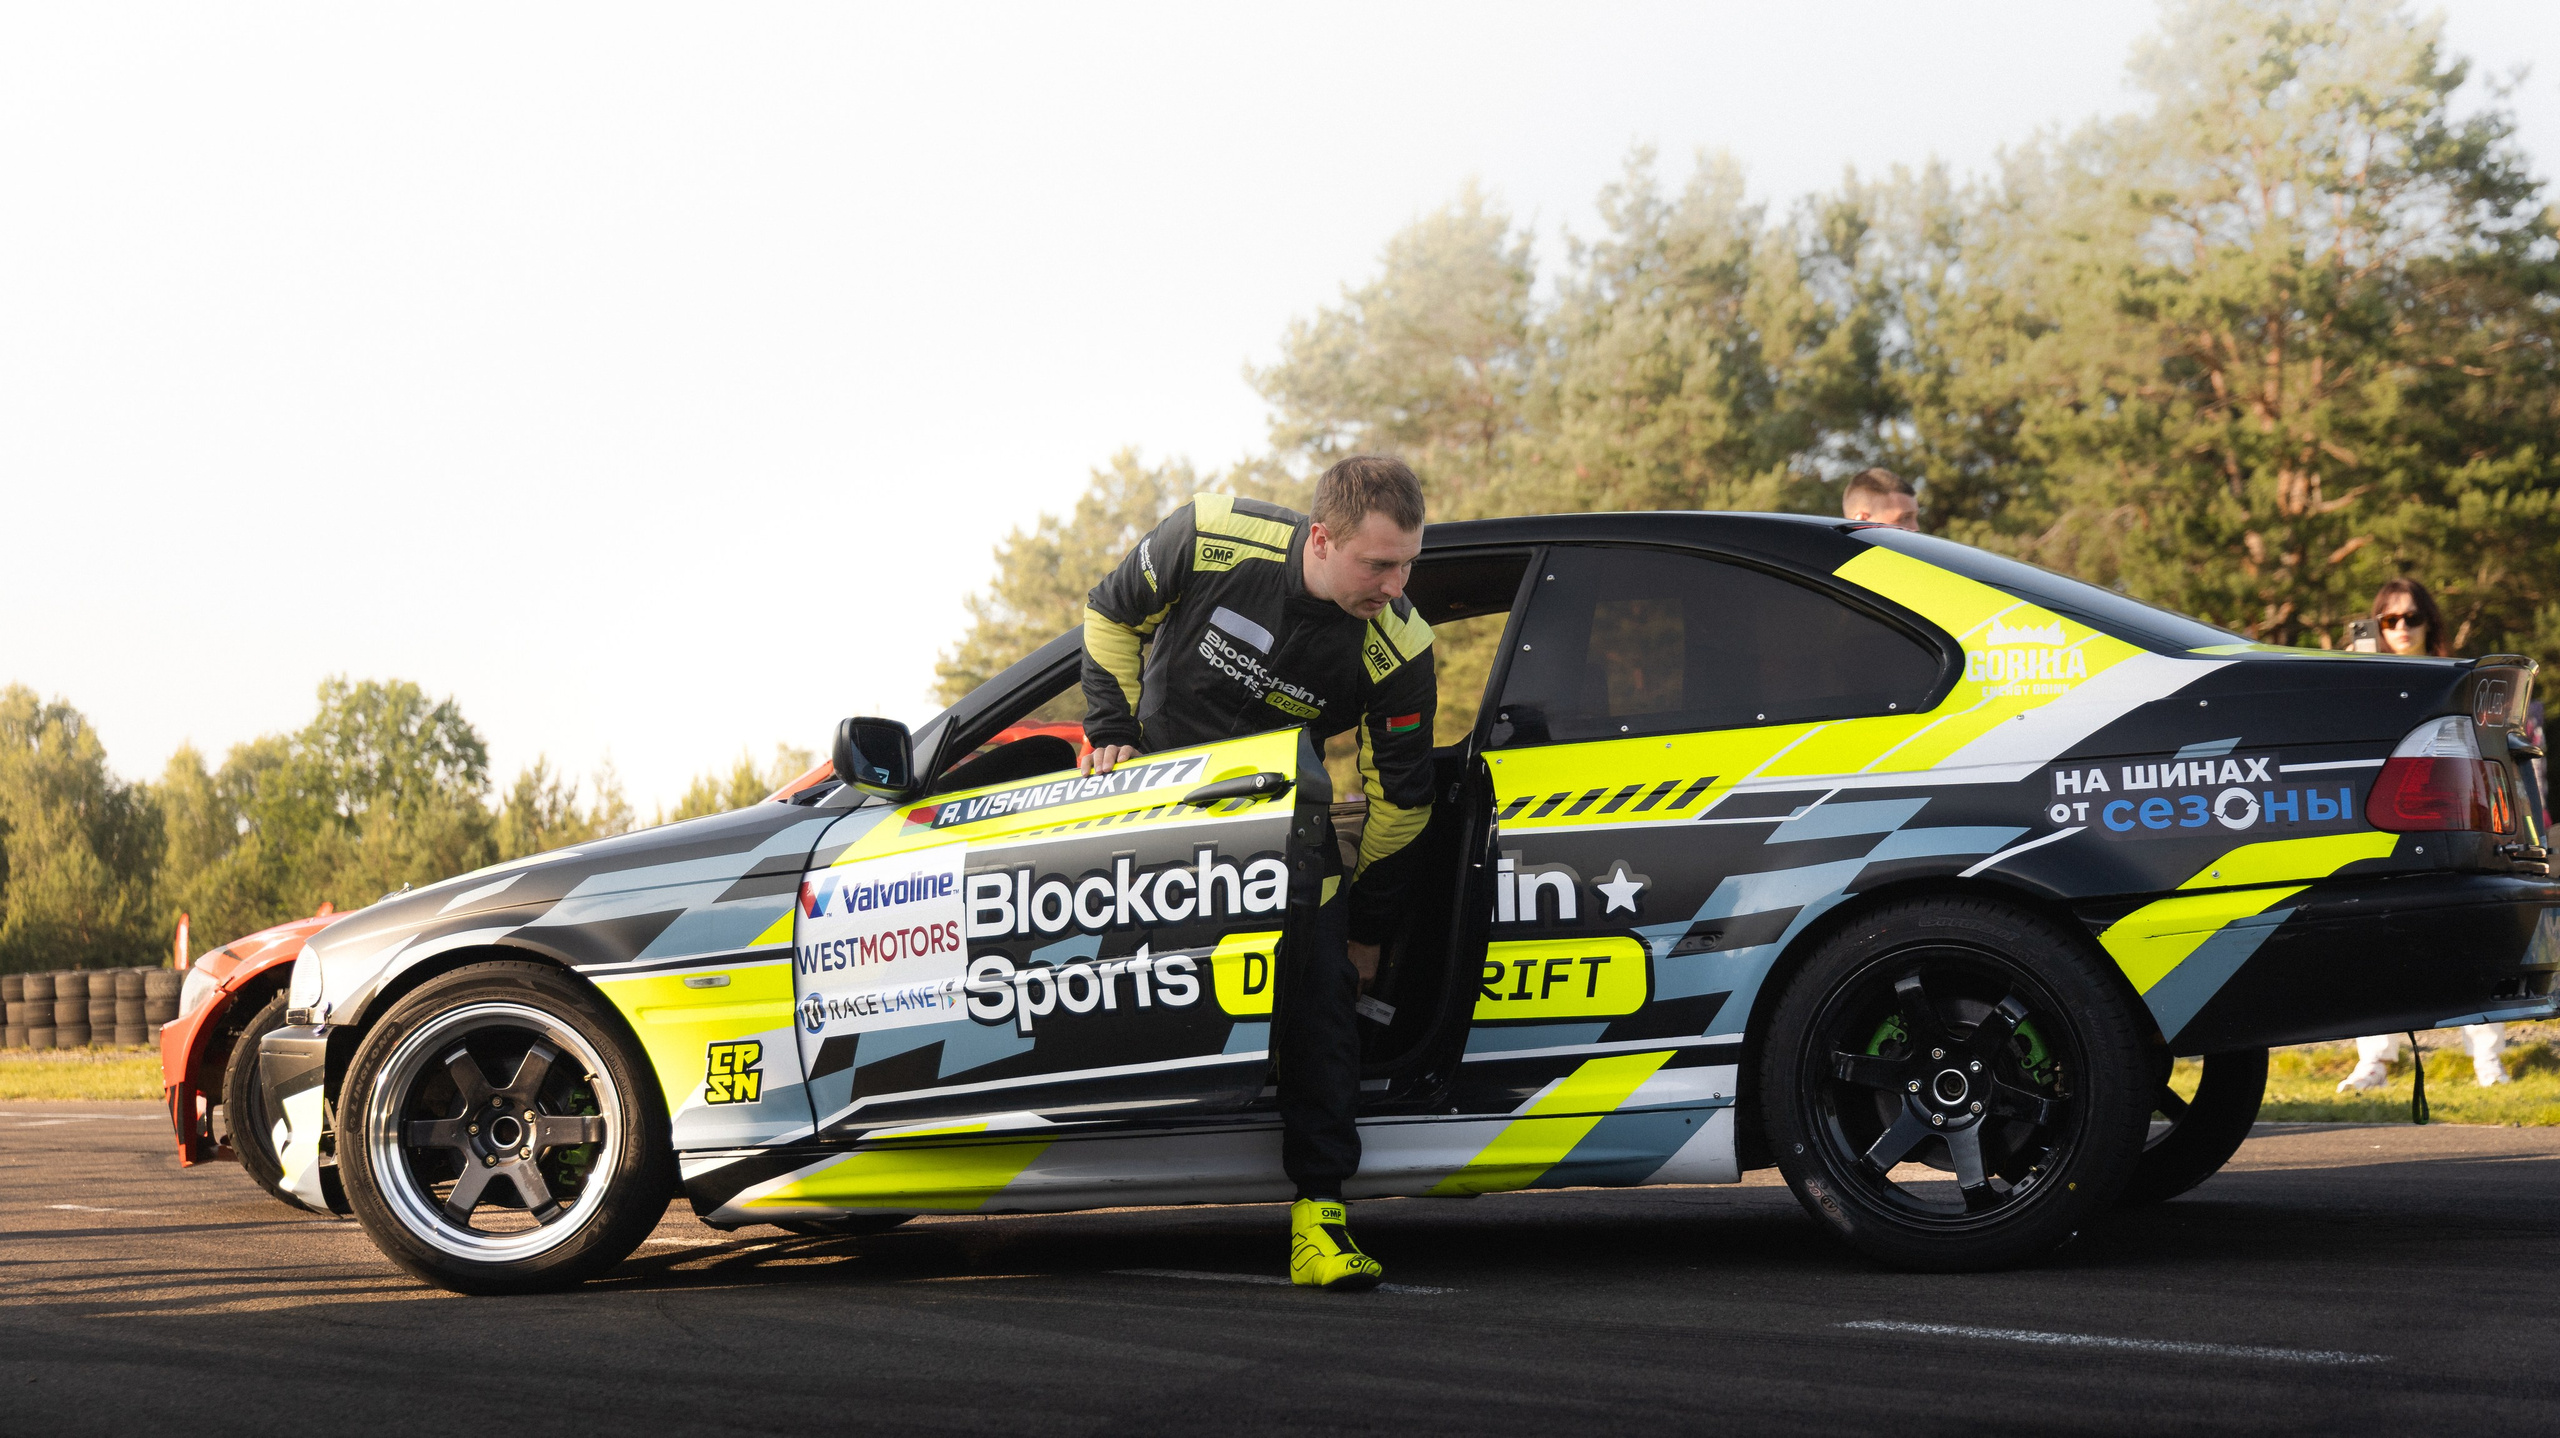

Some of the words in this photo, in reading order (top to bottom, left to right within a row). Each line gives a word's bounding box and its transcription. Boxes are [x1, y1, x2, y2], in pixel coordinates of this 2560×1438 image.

[1202, 547, 1234, 562] OMP
[1204, 629, 1315, 704] Blockchain
[1368, 643, 1391, 671] OMP
[1965, 648, 2088, 682] GORILLA
[1198, 641, 1265, 700] Sports
[1273, 696, 1314, 716] DRIFT
[1982, 684, 2030, 697] ENERGY
[2032, 683, 2071, 695] DRINK
[2488, 692, 2504, 715] LABS
[938, 802, 961, 826] A.
[966, 768, 1142, 820] VISHNEVSKY
[1145, 757, 1204, 787] 77
[2055, 768, 2111, 795] НА
[2121, 757, 2273, 791] ШИНАХ
[842, 871, 954, 914] Valvoline
[796, 920, 960, 976] WESTMOTORS
[828, 994, 879, 1021] RACE
[881, 985, 937, 1014] LANE
[966, 944, 1199, 1031] Sports
[350, 1025, 397, 1113] LINGLONG
[1321, 1209, 1342, 1218] OMP
